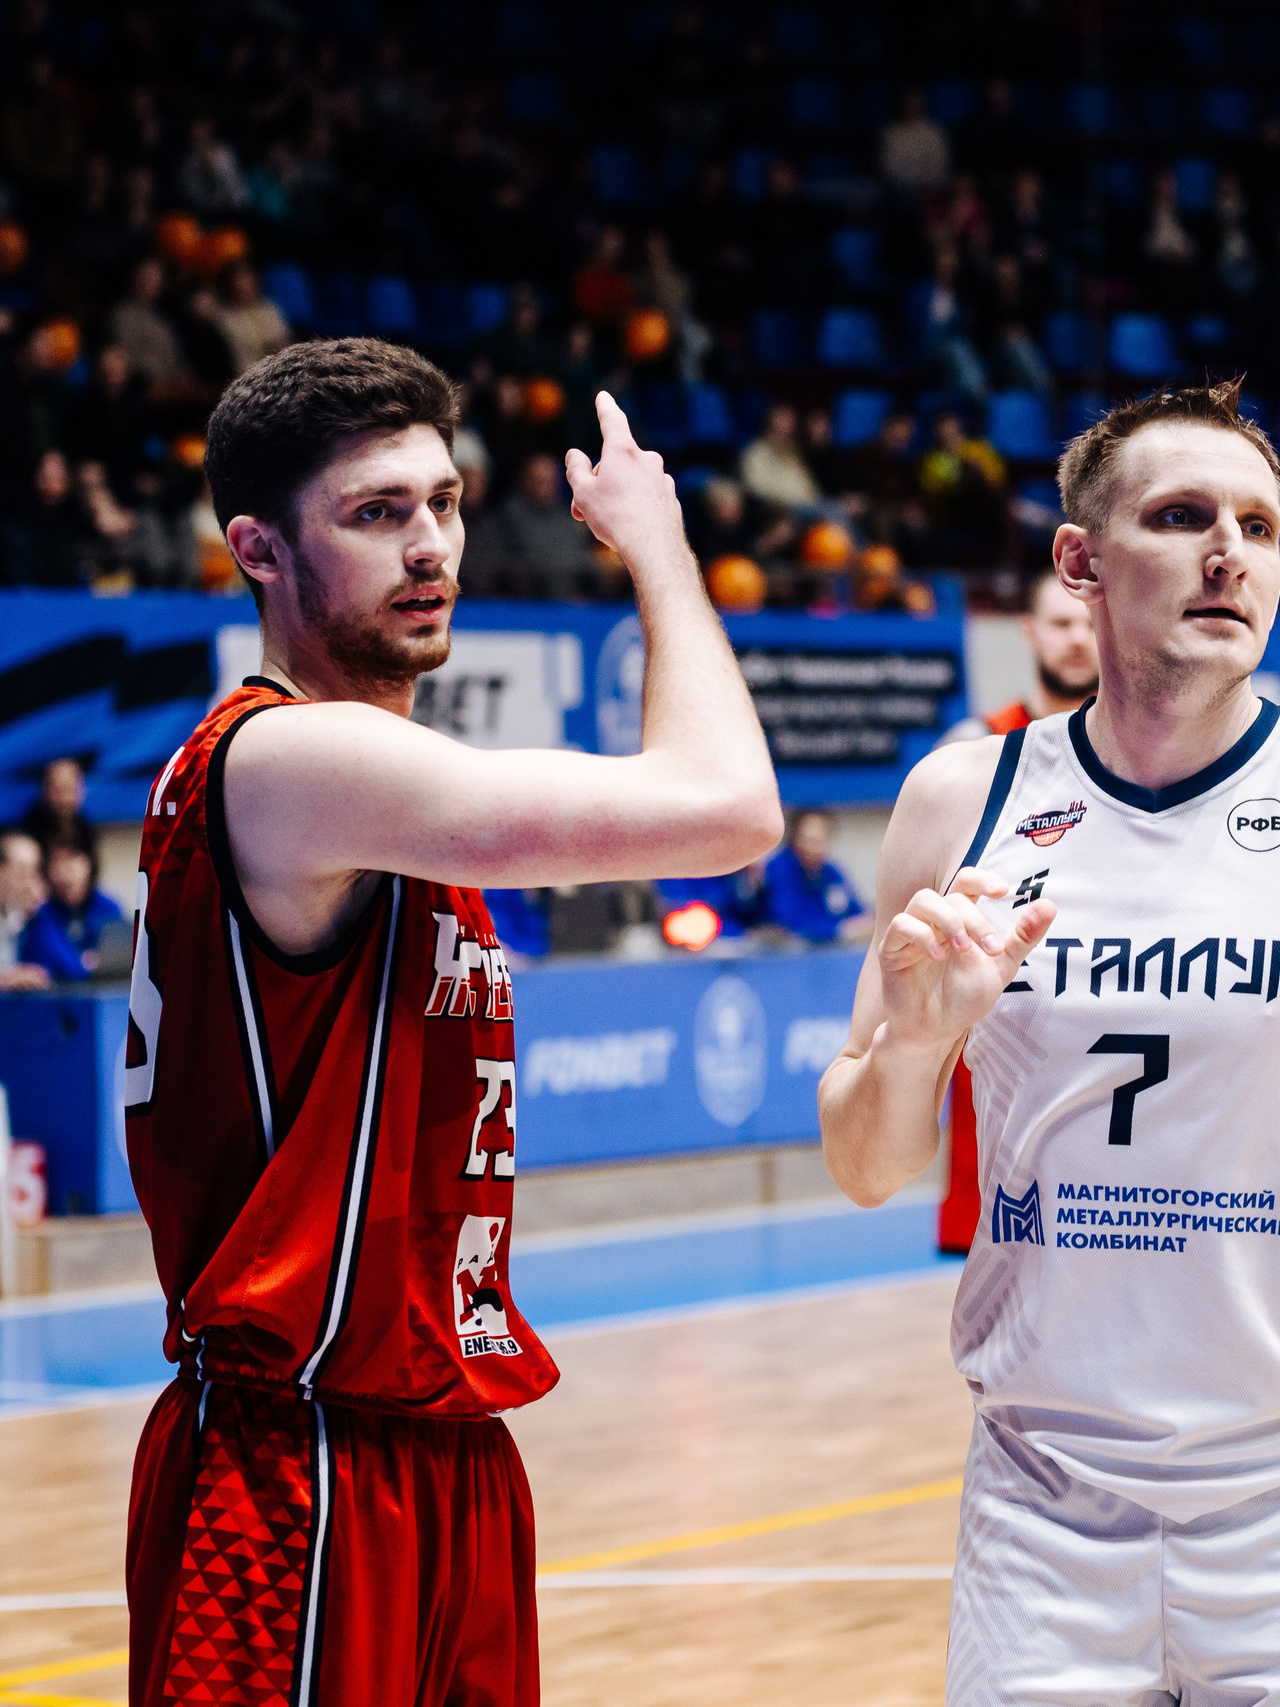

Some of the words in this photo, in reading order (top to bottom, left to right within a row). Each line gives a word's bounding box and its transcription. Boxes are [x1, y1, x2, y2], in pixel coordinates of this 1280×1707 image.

[1017, 809, 1086, 832] МЕТАЛЛУРГ
[1086, 1034, 1170, 1146] 7
[464, 1058, 516, 1176] 23
[1057, 1183, 1276, 1210] МАГНИТОГОРСКИЙ
[1056, 1232, 1188, 1253] КОМБИНАТ
